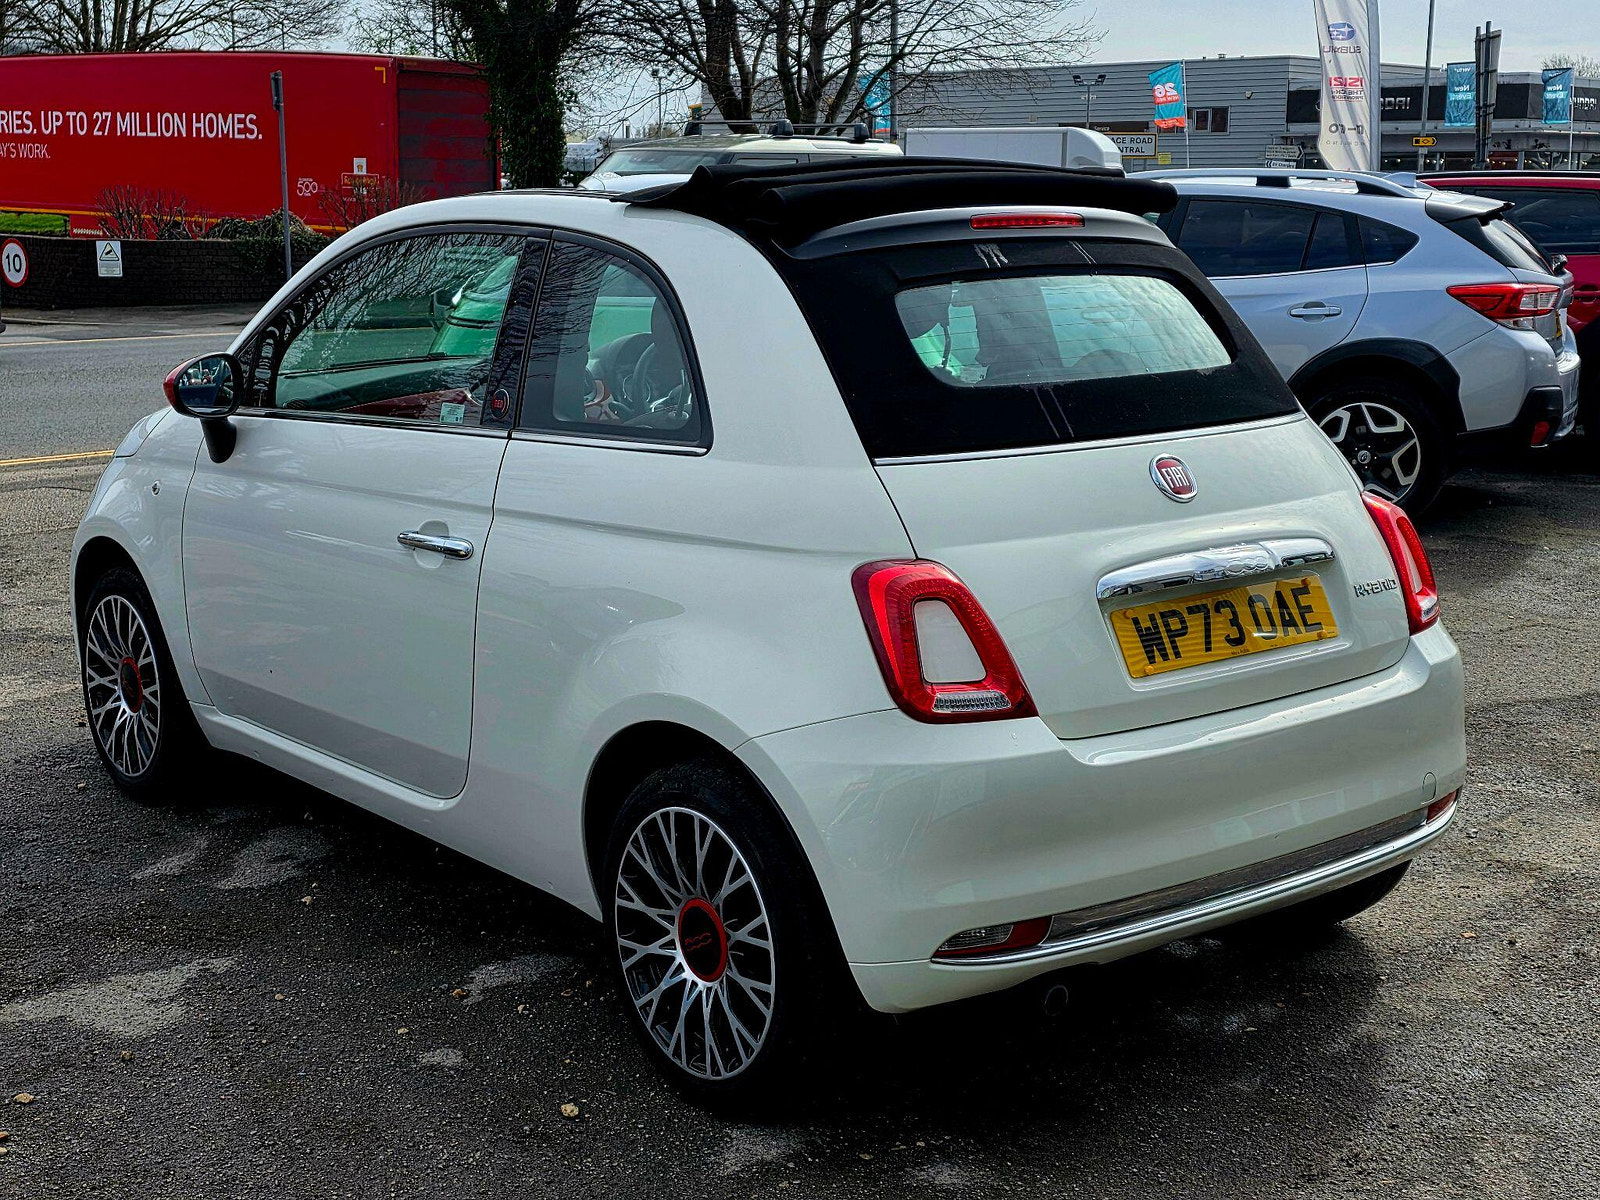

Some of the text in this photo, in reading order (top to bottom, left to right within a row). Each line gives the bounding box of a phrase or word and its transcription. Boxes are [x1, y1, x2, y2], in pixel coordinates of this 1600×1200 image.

[0, 110, 263, 139] RIES. UP TO 27 MILLION HOMES.
[18, 143, 51, 159] WORK.
[297, 181, 318, 196] 500
[5, 253, 22, 274] 10
[1162, 466, 1191, 489] FIAT
[1131, 586, 1323, 664] WP73 OAE
